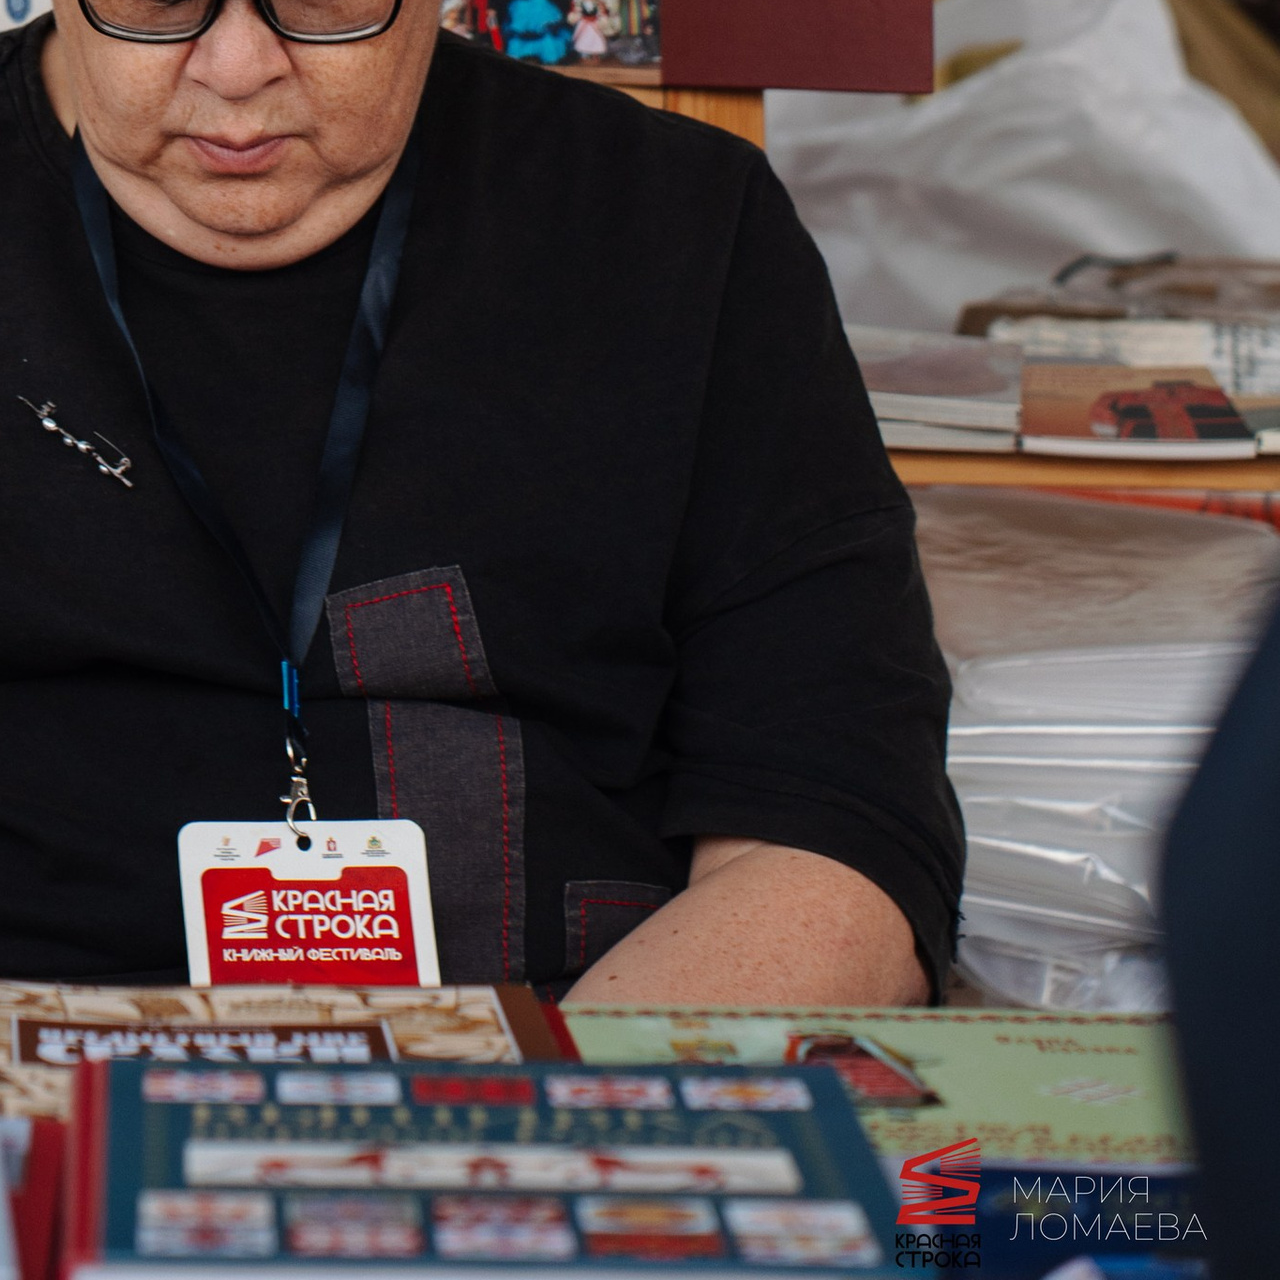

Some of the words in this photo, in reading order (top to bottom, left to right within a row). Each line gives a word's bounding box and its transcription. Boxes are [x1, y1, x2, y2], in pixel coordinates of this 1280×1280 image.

[271, 889, 395, 912] КРАСНАЯ
[274, 914, 400, 939] СТРОКА
[222, 945, 305, 962] КНИЖНЫЙ
[307, 947, 403, 961] ФЕСТИВАЛЬ
